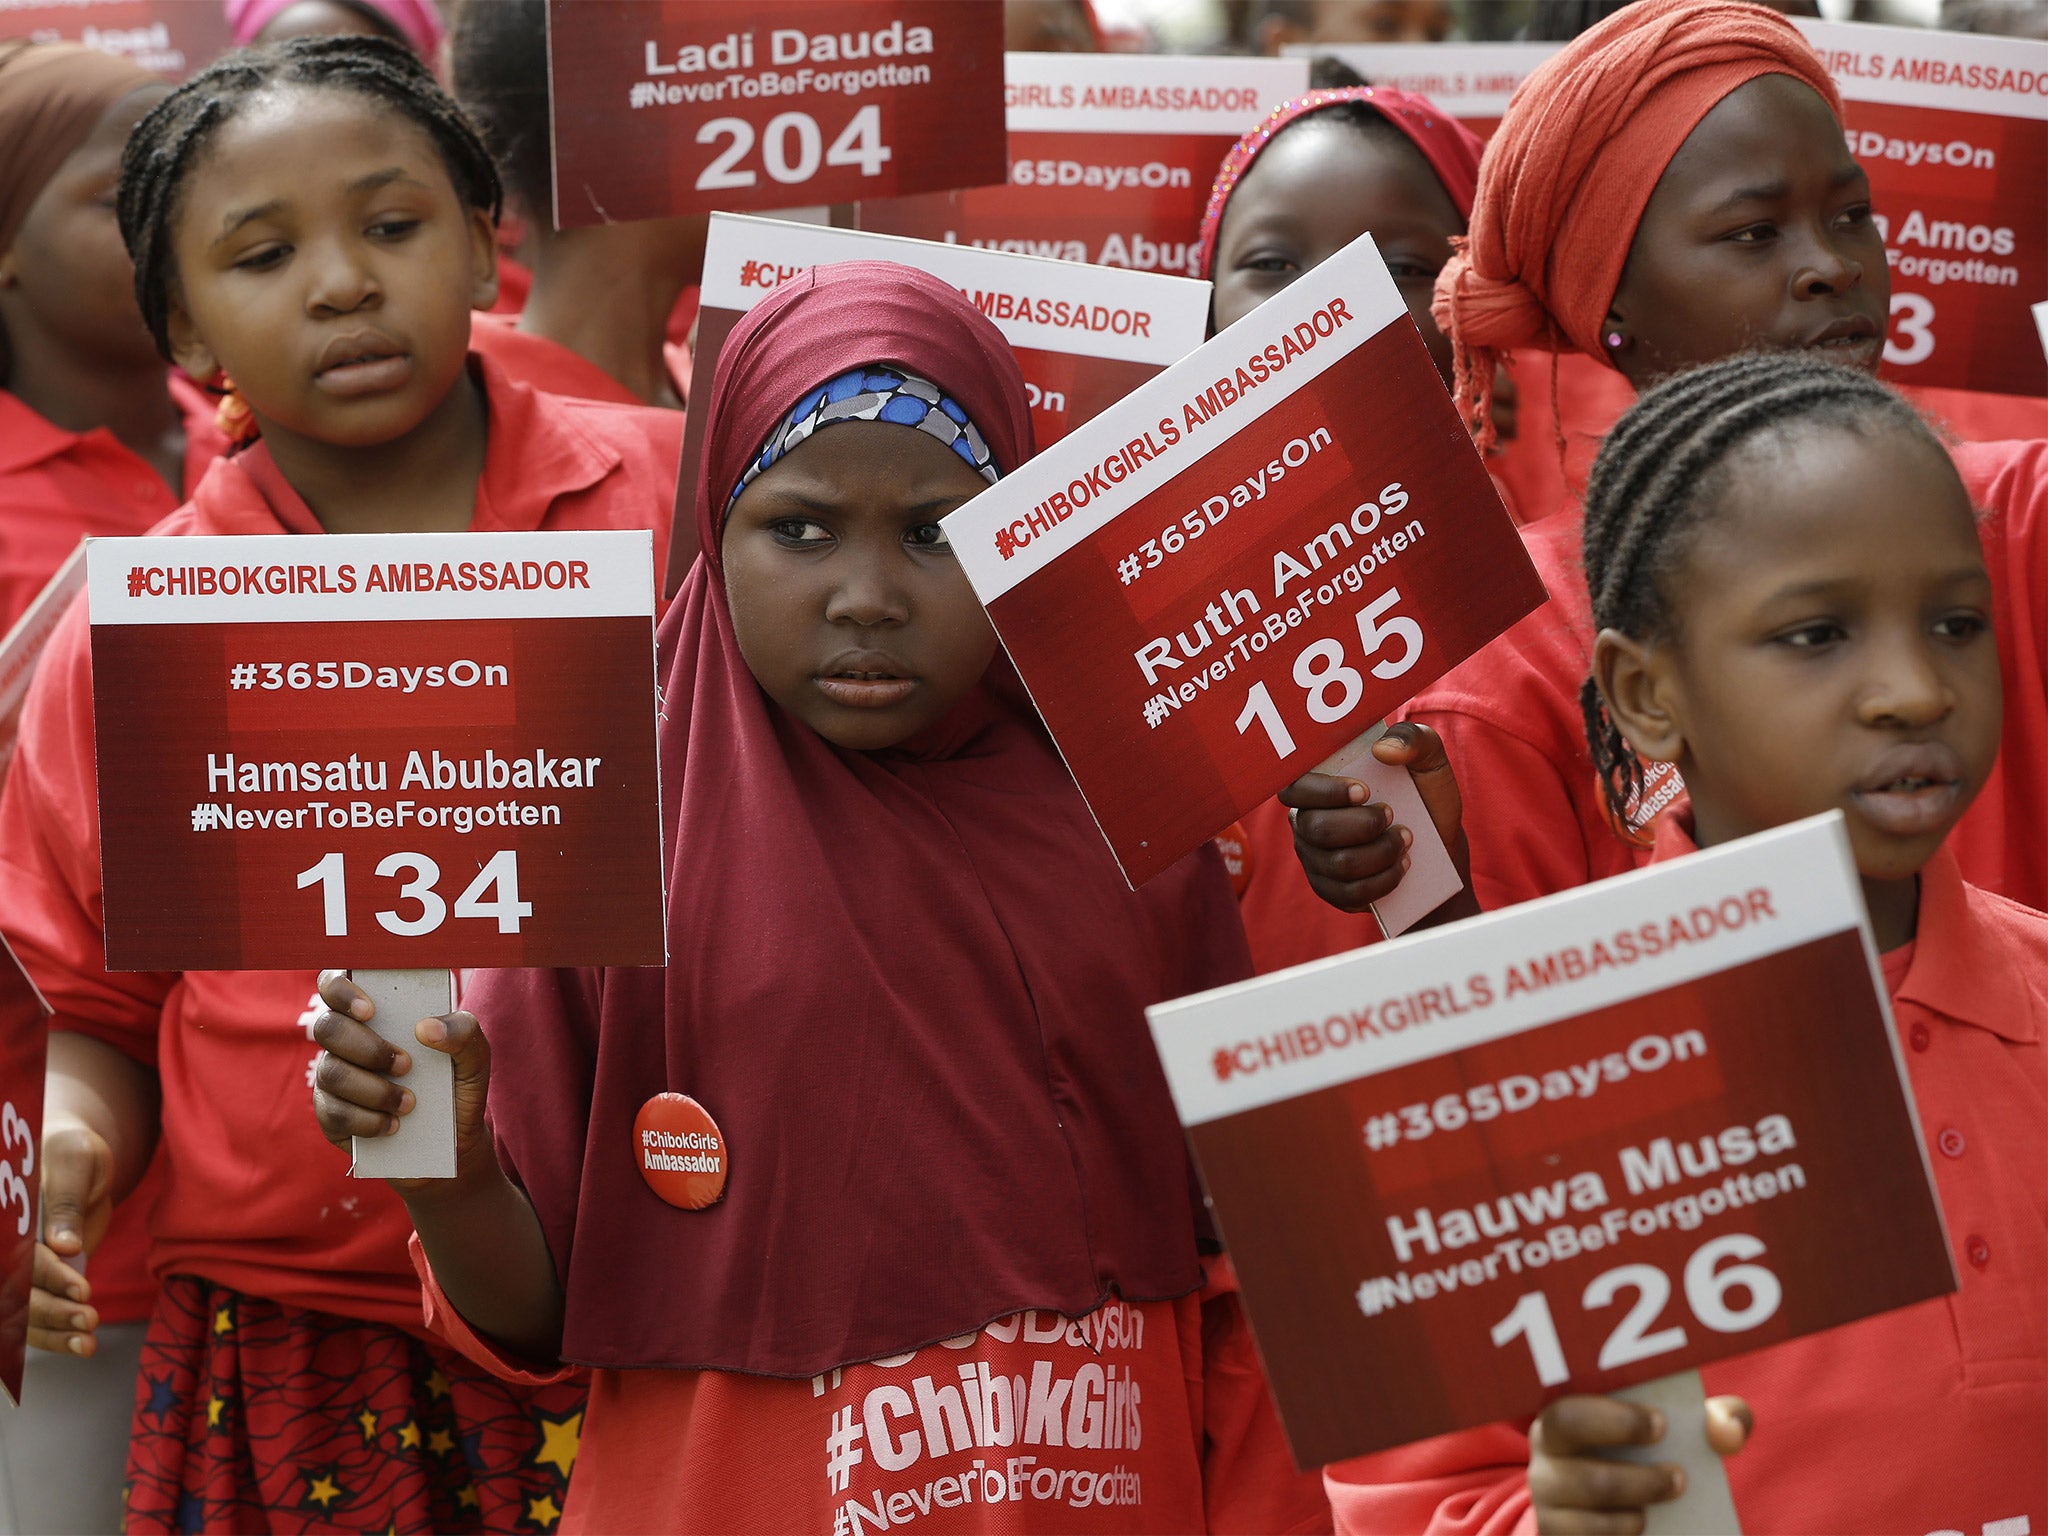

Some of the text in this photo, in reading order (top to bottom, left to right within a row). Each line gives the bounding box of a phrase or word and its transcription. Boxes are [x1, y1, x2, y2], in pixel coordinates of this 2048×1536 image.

[630, 64, 930, 109] #NeverToBeForgotten
[645, 21, 933, 75] Ladi Dauda
[1081, 85, 1258, 111] AMBASSADOR
[695, 105, 892, 190] 204
[1896, 208, 2015, 256] Amos
[741, 260, 1152, 338] #CH MBASSADOR
[994, 297, 1354, 561] #CHIBOKGIRLS AMBASSADOR
[1117, 427, 1333, 586] #365DaysOn
[127, 561, 590, 597] #CHIBOKGIRLS AMBASSADOR
[1134, 482, 1409, 685] Ruth Amos
[1142, 519, 1426, 729] #NeverToBeForgotten
[230, 660, 509, 693] #365DaysOn
[1234, 586, 1424, 760] 185
[207, 749, 601, 792] Hamsatu Abubakar
[191, 801, 561, 833] #NeverToBeForgotten
[296, 850, 533, 937] 134
[1209, 887, 1777, 1084] #CHIBOKGIRLS AMBASSADOR
[1363, 1027, 1707, 1151] #365DaysOn
[642, 1130, 719, 1150] #ChibokGirls
[644, 1148, 720, 1173] Ambassador
[1386, 1113, 1797, 1263] Hauwa Musa
[1355, 1163, 1806, 1317] #NeverToBeForgotten
[1490, 1233, 1782, 1387] 126
